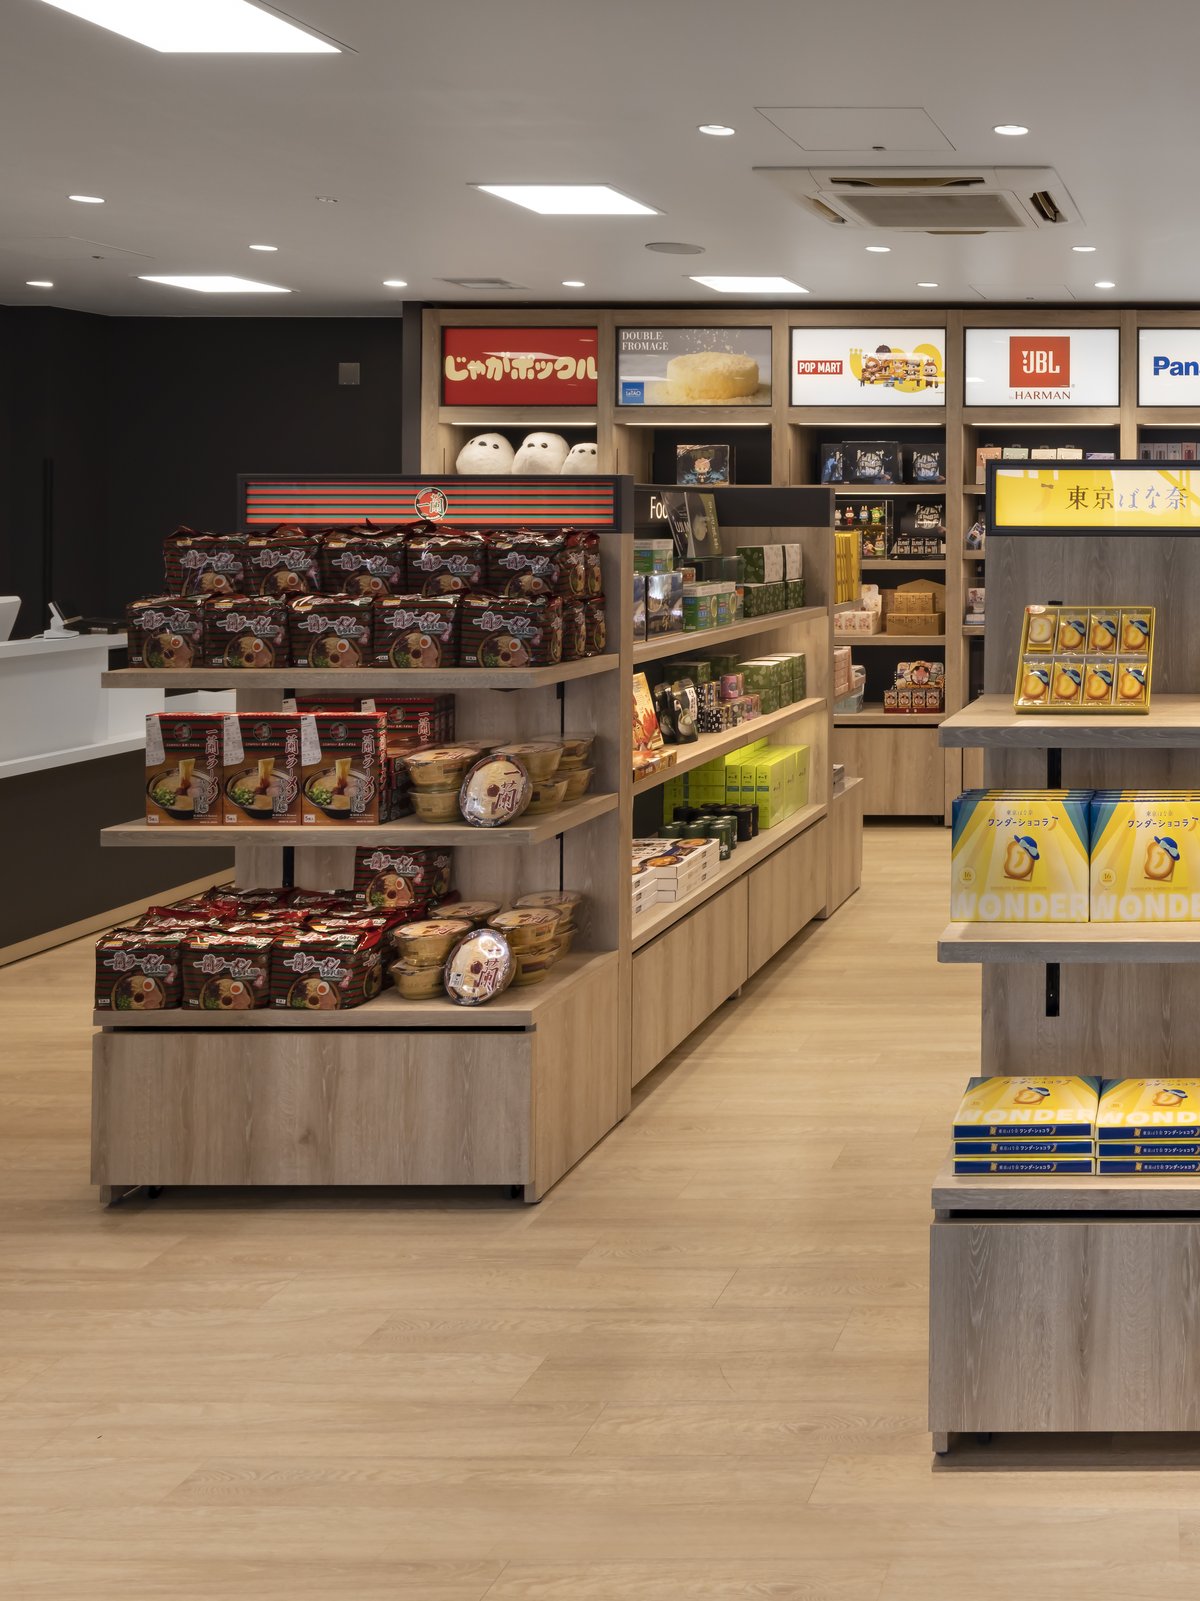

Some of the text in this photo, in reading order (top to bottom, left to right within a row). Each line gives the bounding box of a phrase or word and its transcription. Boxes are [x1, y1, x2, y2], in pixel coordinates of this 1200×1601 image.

[622, 331, 662, 340] DOUBLE
[622, 342, 669, 350] FROMAGE
[800, 362, 842, 373] POP MART
[1022, 350, 1060, 374] JBL
[1015, 391, 1071, 400] HARMAN
[650, 496, 668, 519] Foo
[1066, 486, 1188, 511] 東京ばな奈
[206, 729, 219, 802] 一蘭ラーメン
[285, 729, 298, 802] 一蘭ラーメン
[362, 729, 376, 802] 一蘭ラーメン
[495, 770, 522, 813] 一蘭
[988, 817, 1049, 827] ワンダーショコラ
[1128, 818, 1189, 828] ワンダーショコラ
[952, 894, 1088, 919] WONDER
[958, 1108, 1094, 1122] WONDER
